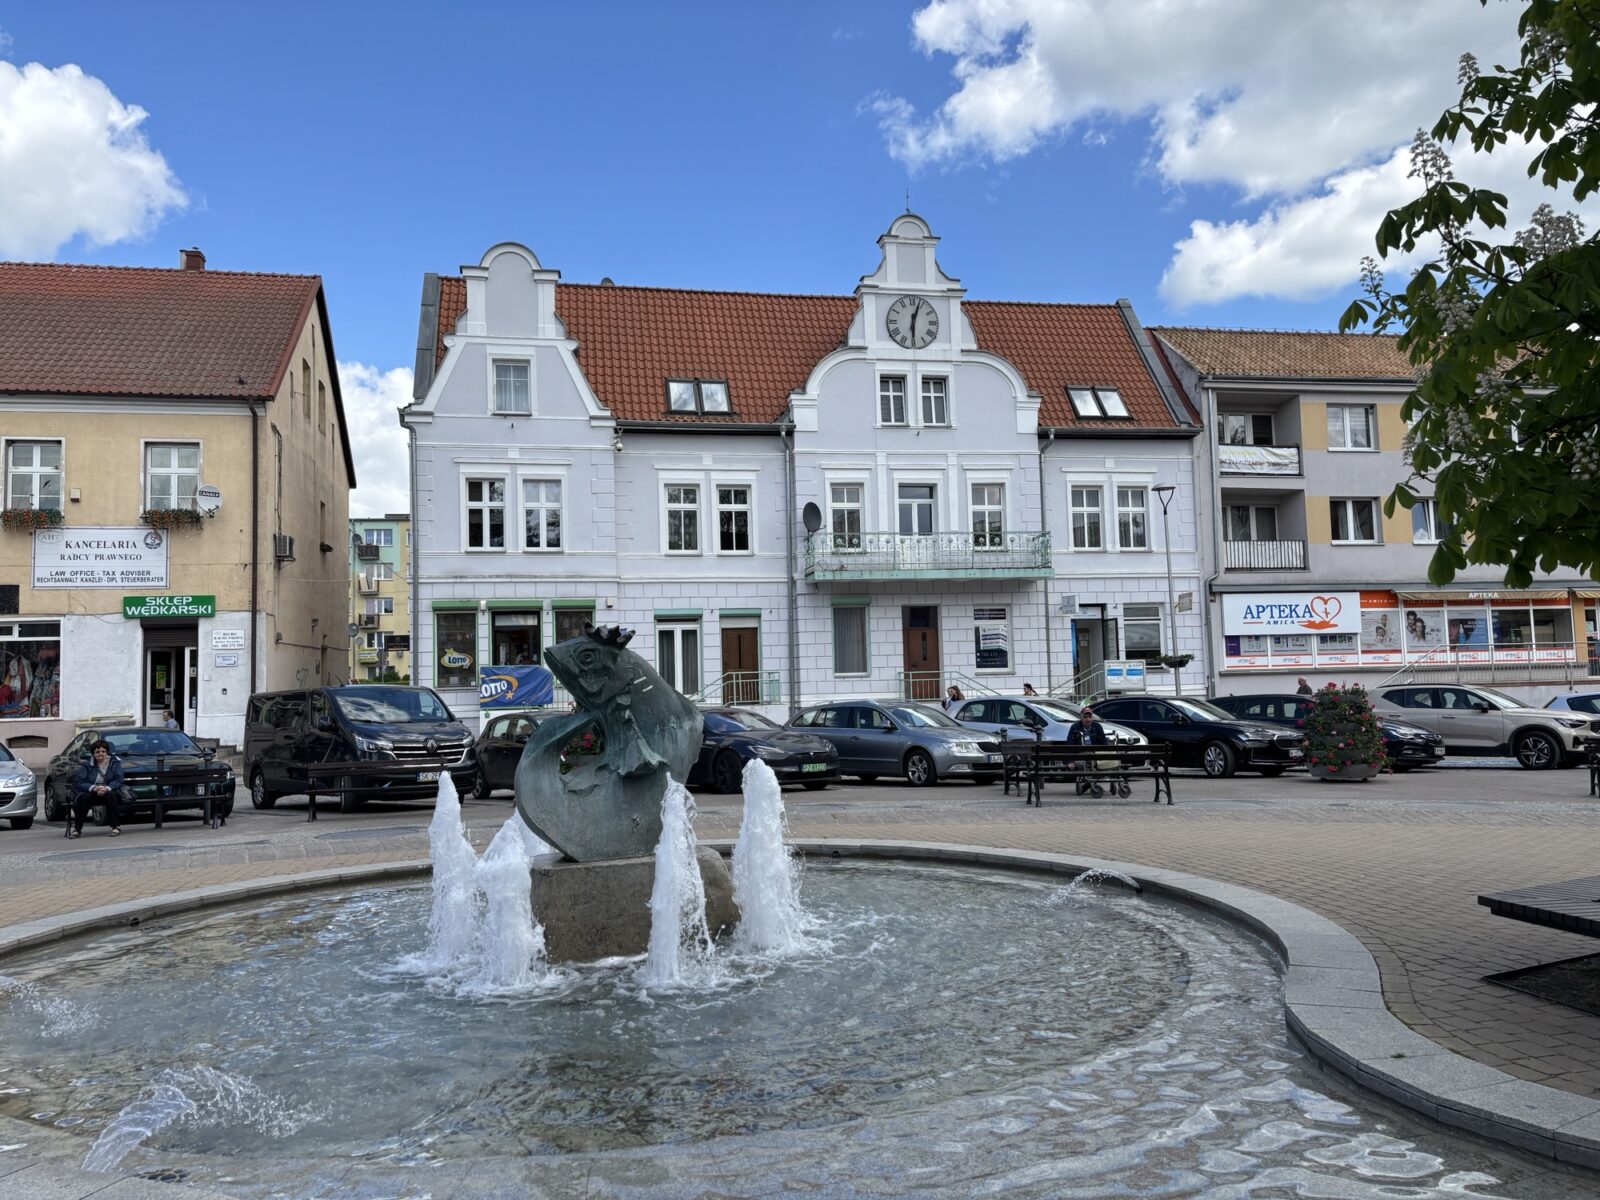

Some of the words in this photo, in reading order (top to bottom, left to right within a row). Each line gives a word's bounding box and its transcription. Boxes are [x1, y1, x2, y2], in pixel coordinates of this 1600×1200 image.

[65, 540, 138, 549] KANCELARIA
[94, 553, 142, 561] PRAWNEGO
[145, 596, 193, 606] SKLEP
[125, 605, 212, 616] WĘDKARSKI
[1242, 604, 1314, 619] APTEKA
[448, 656, 467, 664] LOTTO
[480, 680, 508, 697] OTTO
